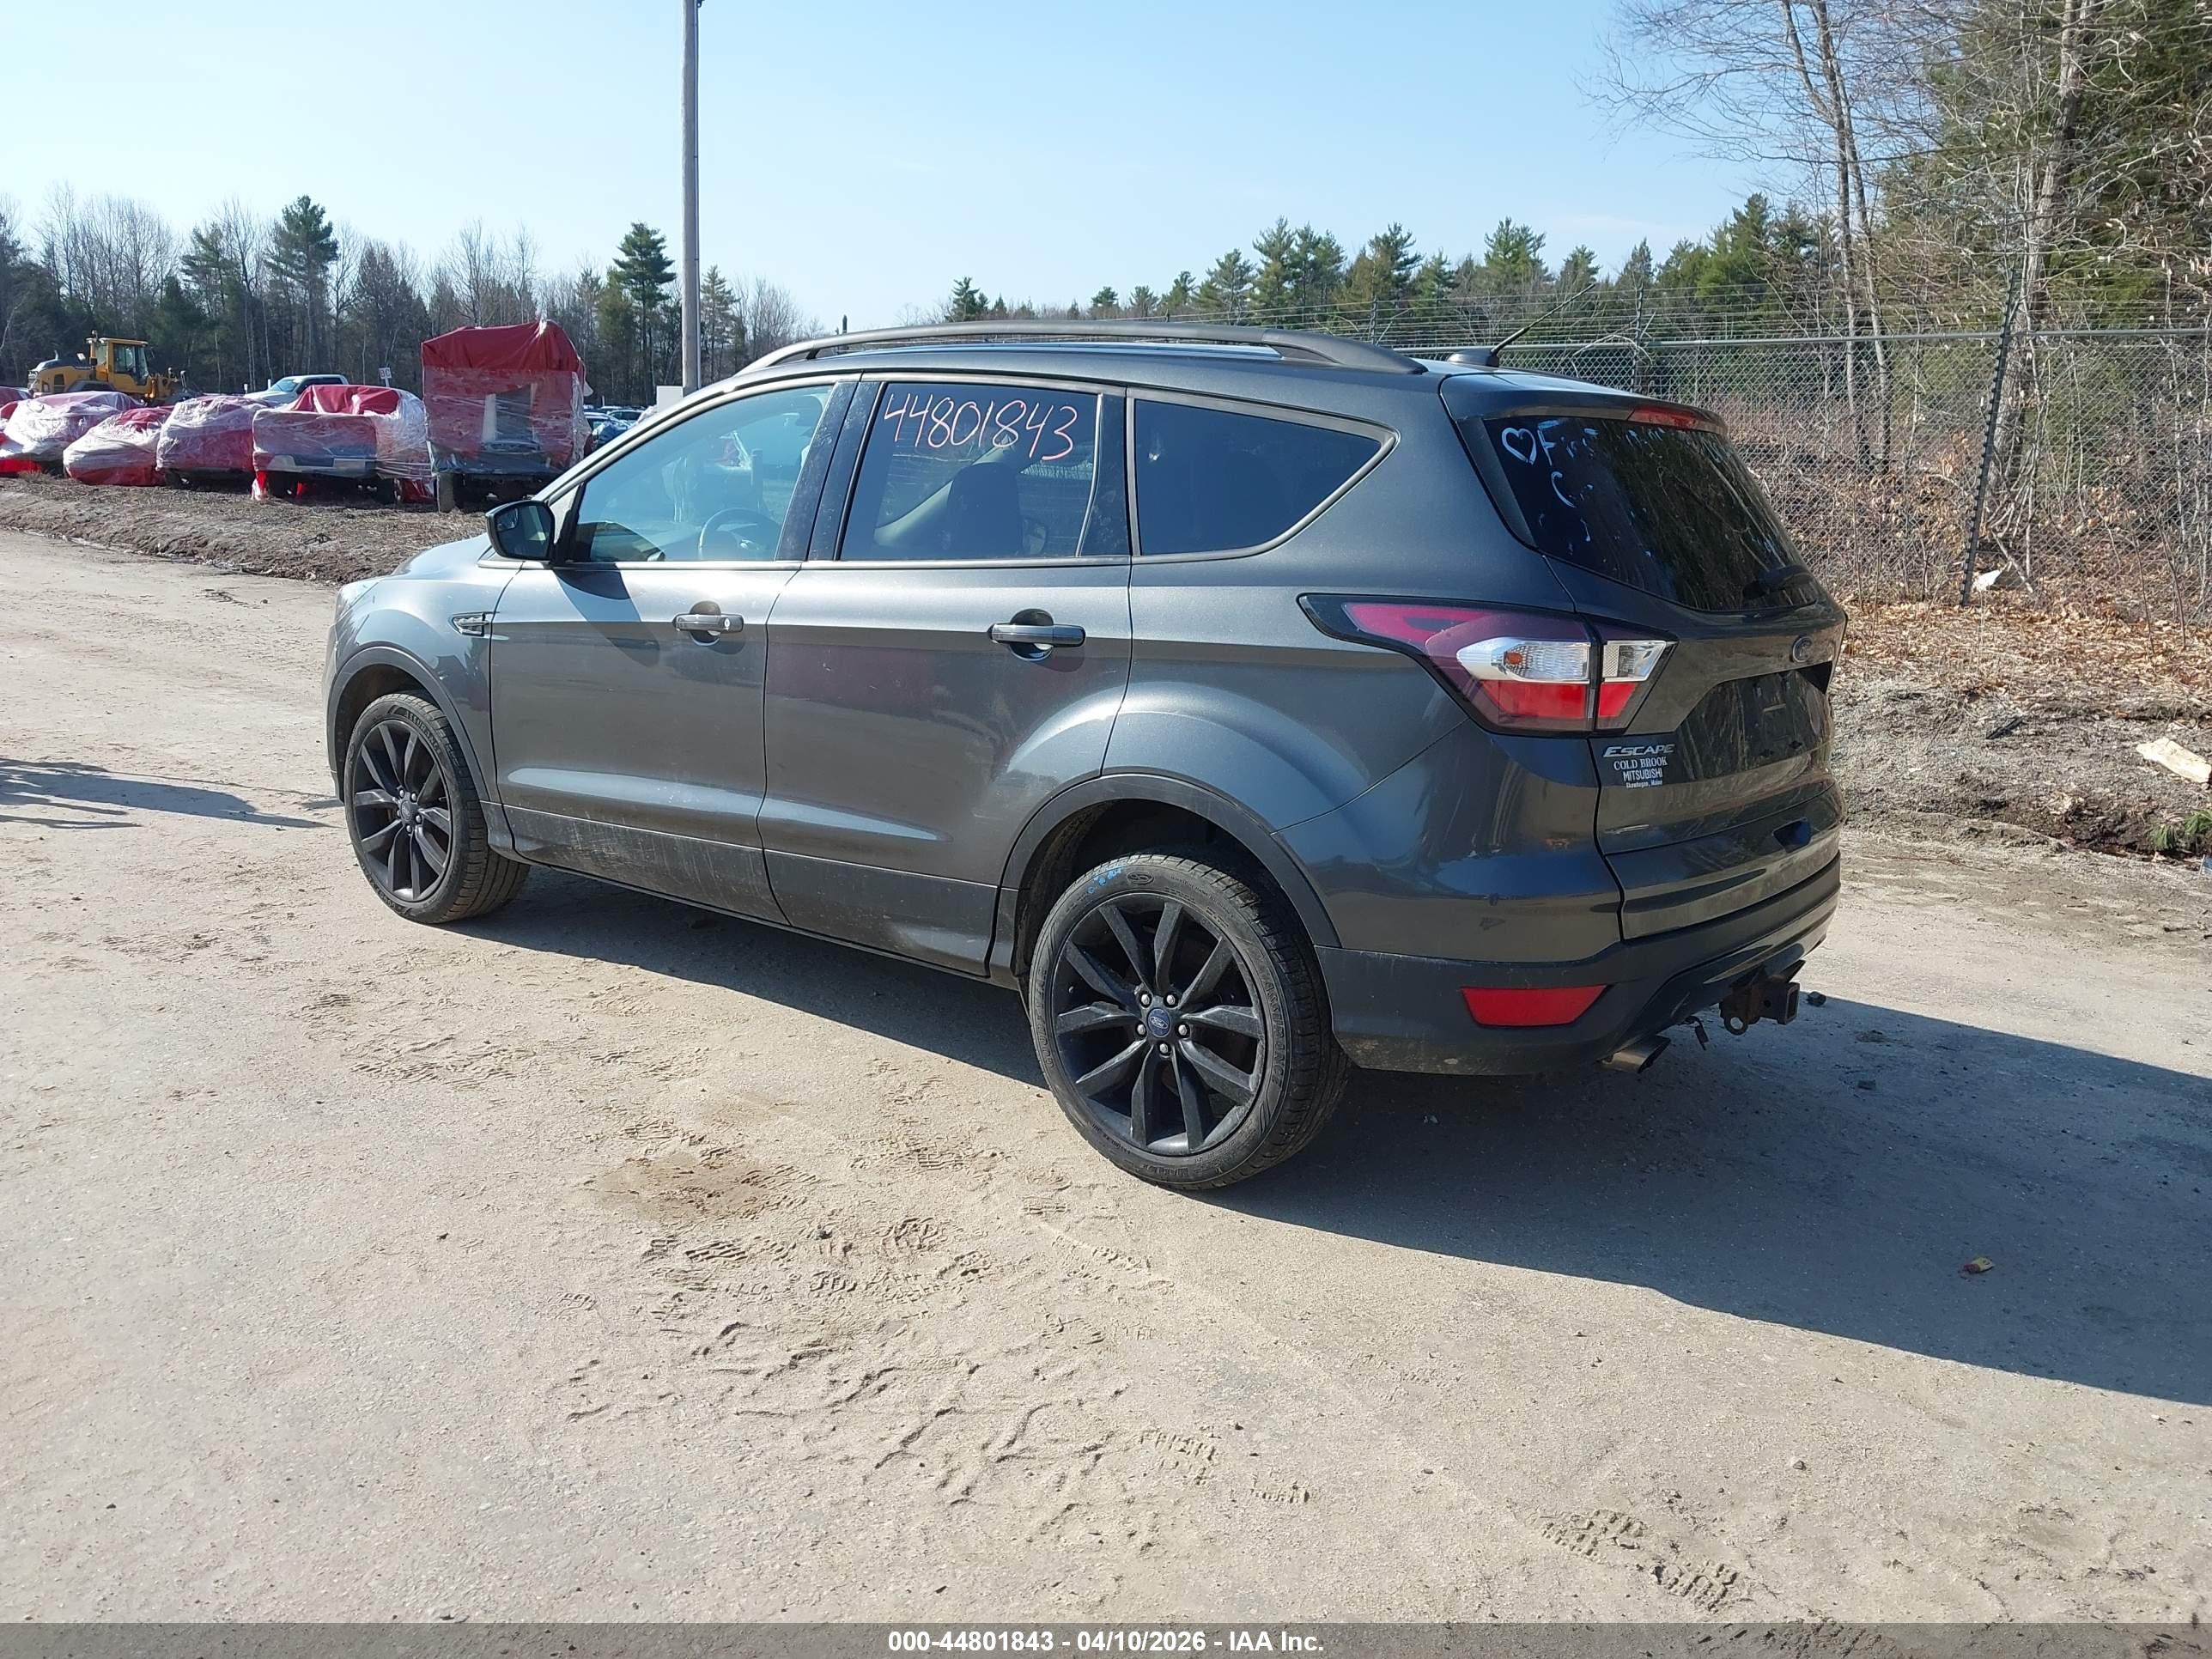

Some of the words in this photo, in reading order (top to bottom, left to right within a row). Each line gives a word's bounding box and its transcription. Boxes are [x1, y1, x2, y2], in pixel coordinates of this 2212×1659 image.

[884, 392, 1078, 461] 44801843
[1603, 744, 1675, 757] ESCAPE
[1613, 759, 1638, 770] COLD
[1639, 757, 1668, 768] BROOK
[1623, 768, 1663, 781] MITSUBISHI
